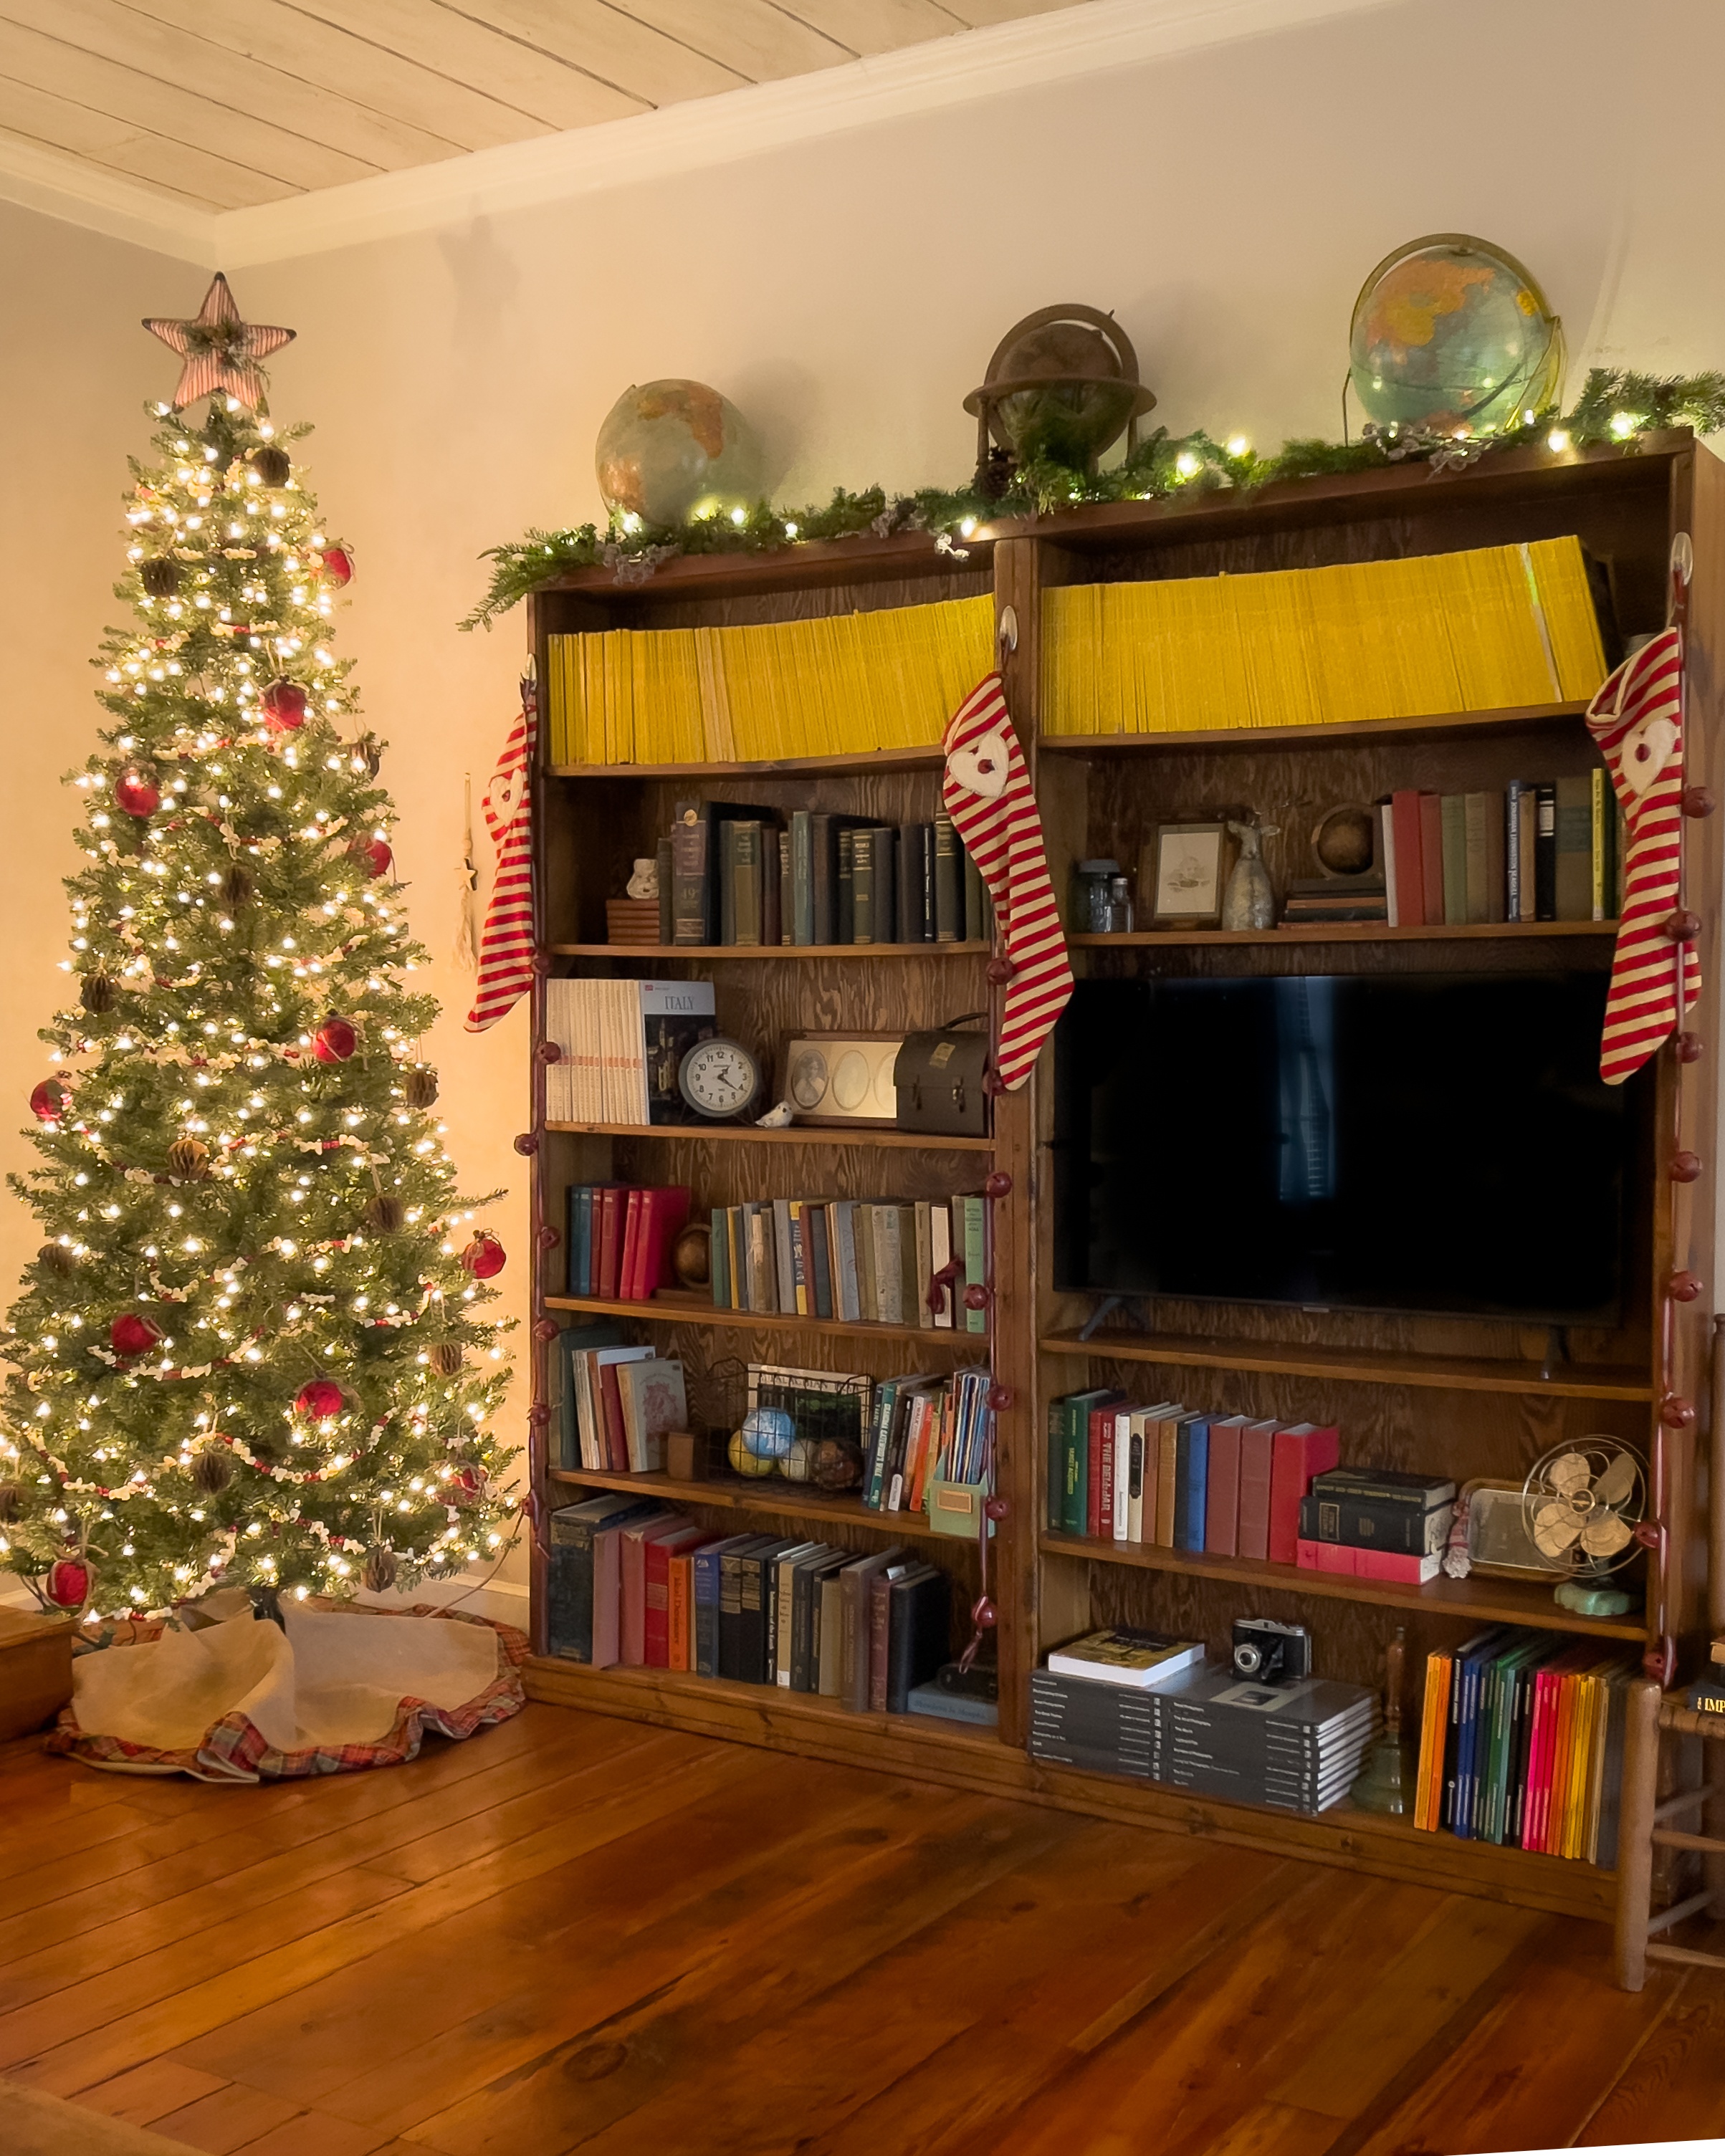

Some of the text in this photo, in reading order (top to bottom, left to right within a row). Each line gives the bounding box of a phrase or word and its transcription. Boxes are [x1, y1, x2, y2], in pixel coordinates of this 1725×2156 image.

[1509, 834, 1518, 869] LIVINGSTON
[665, 996, 694, 1010] ITALY
[1102, 1442, 1112, 1510] THE BELL JAR
